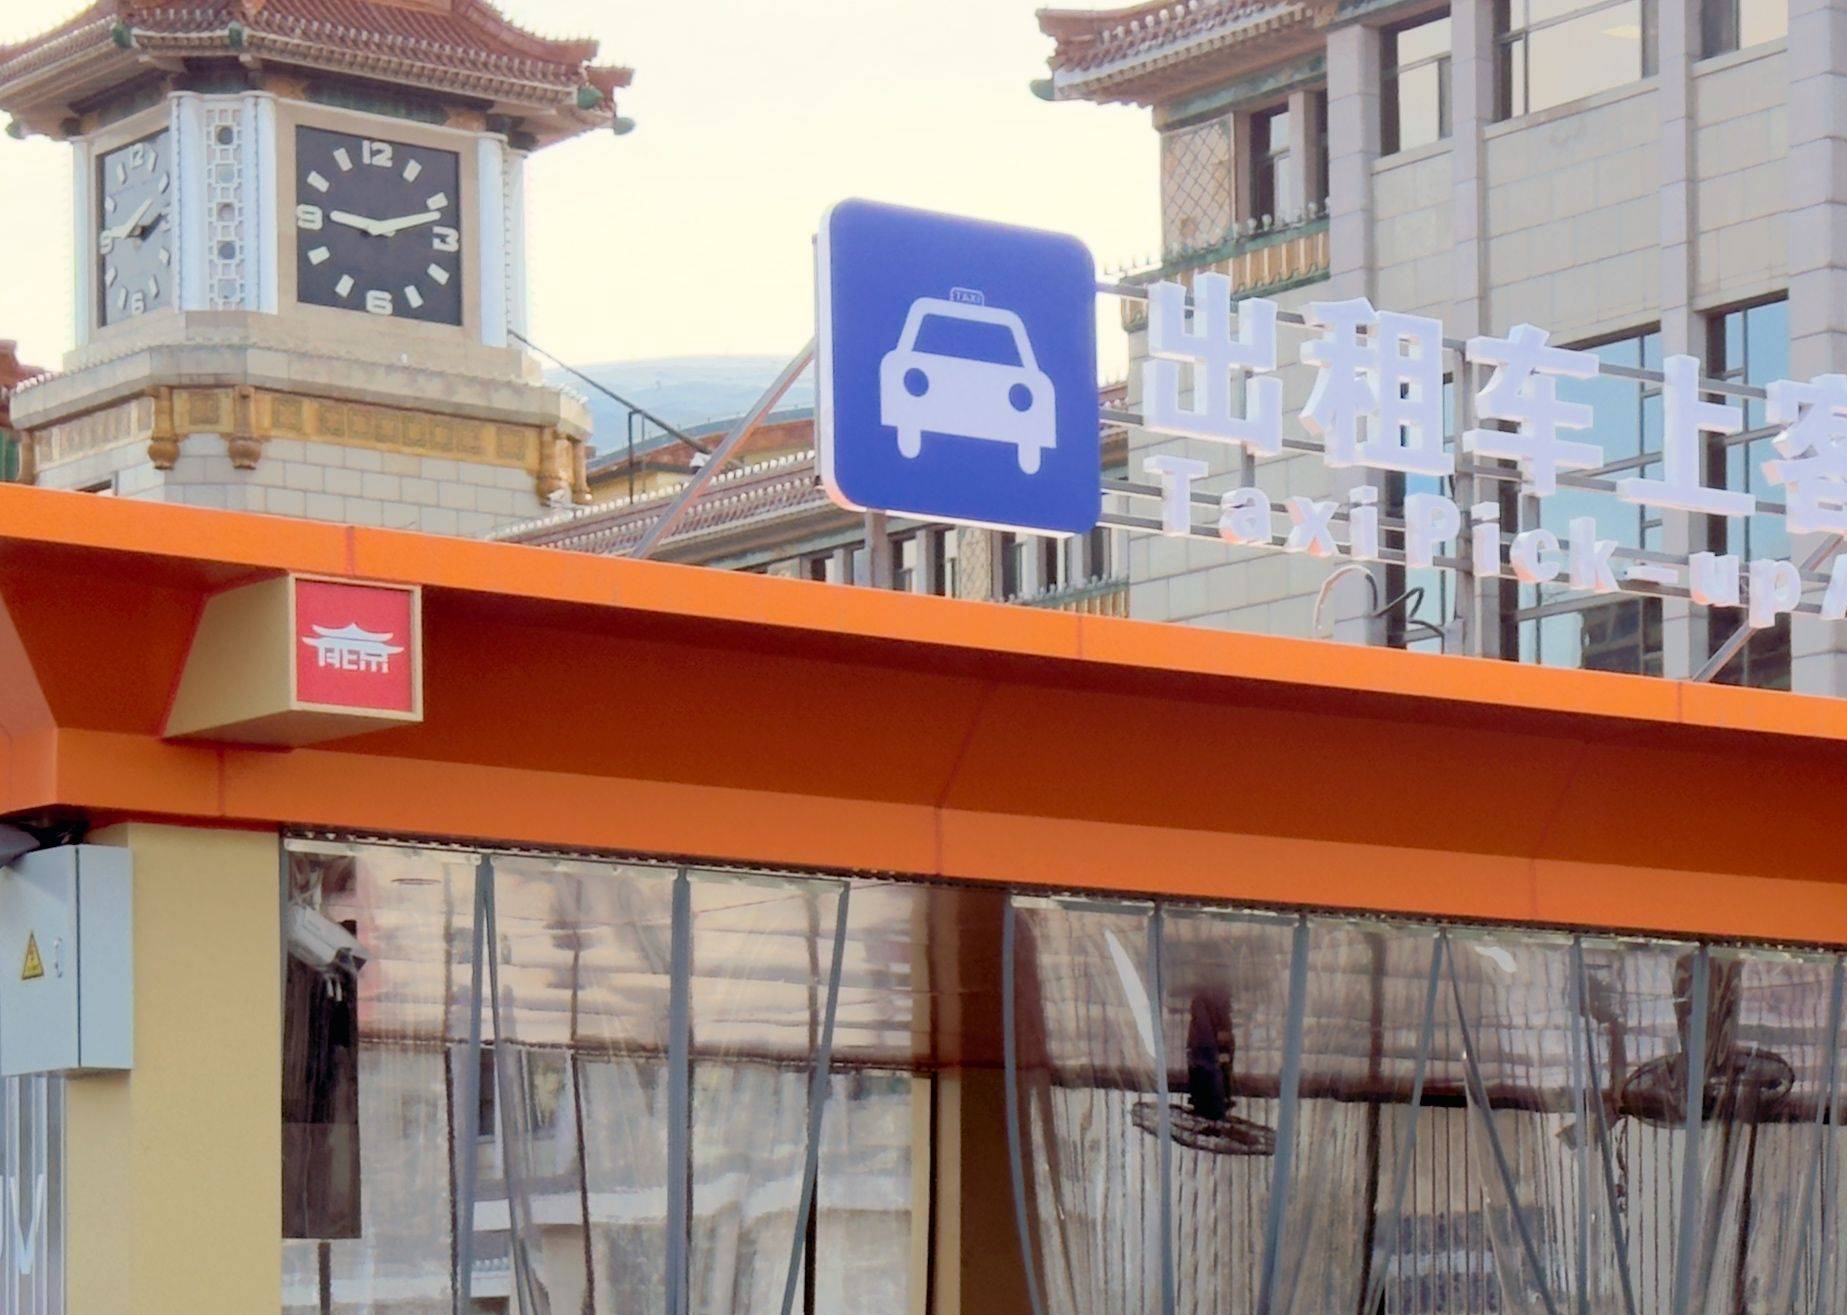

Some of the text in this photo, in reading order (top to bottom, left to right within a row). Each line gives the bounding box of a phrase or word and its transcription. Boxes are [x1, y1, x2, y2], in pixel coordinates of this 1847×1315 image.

[362, 140, 393, 168] 12
[297, 203, 323, 230] 9
[432, 226, 459, 253] 3
[366, 289, 393, 316] 6
[1143, 454, 1379, 560] Taxi
[1404, 491, 1801, 629] Pick-up
